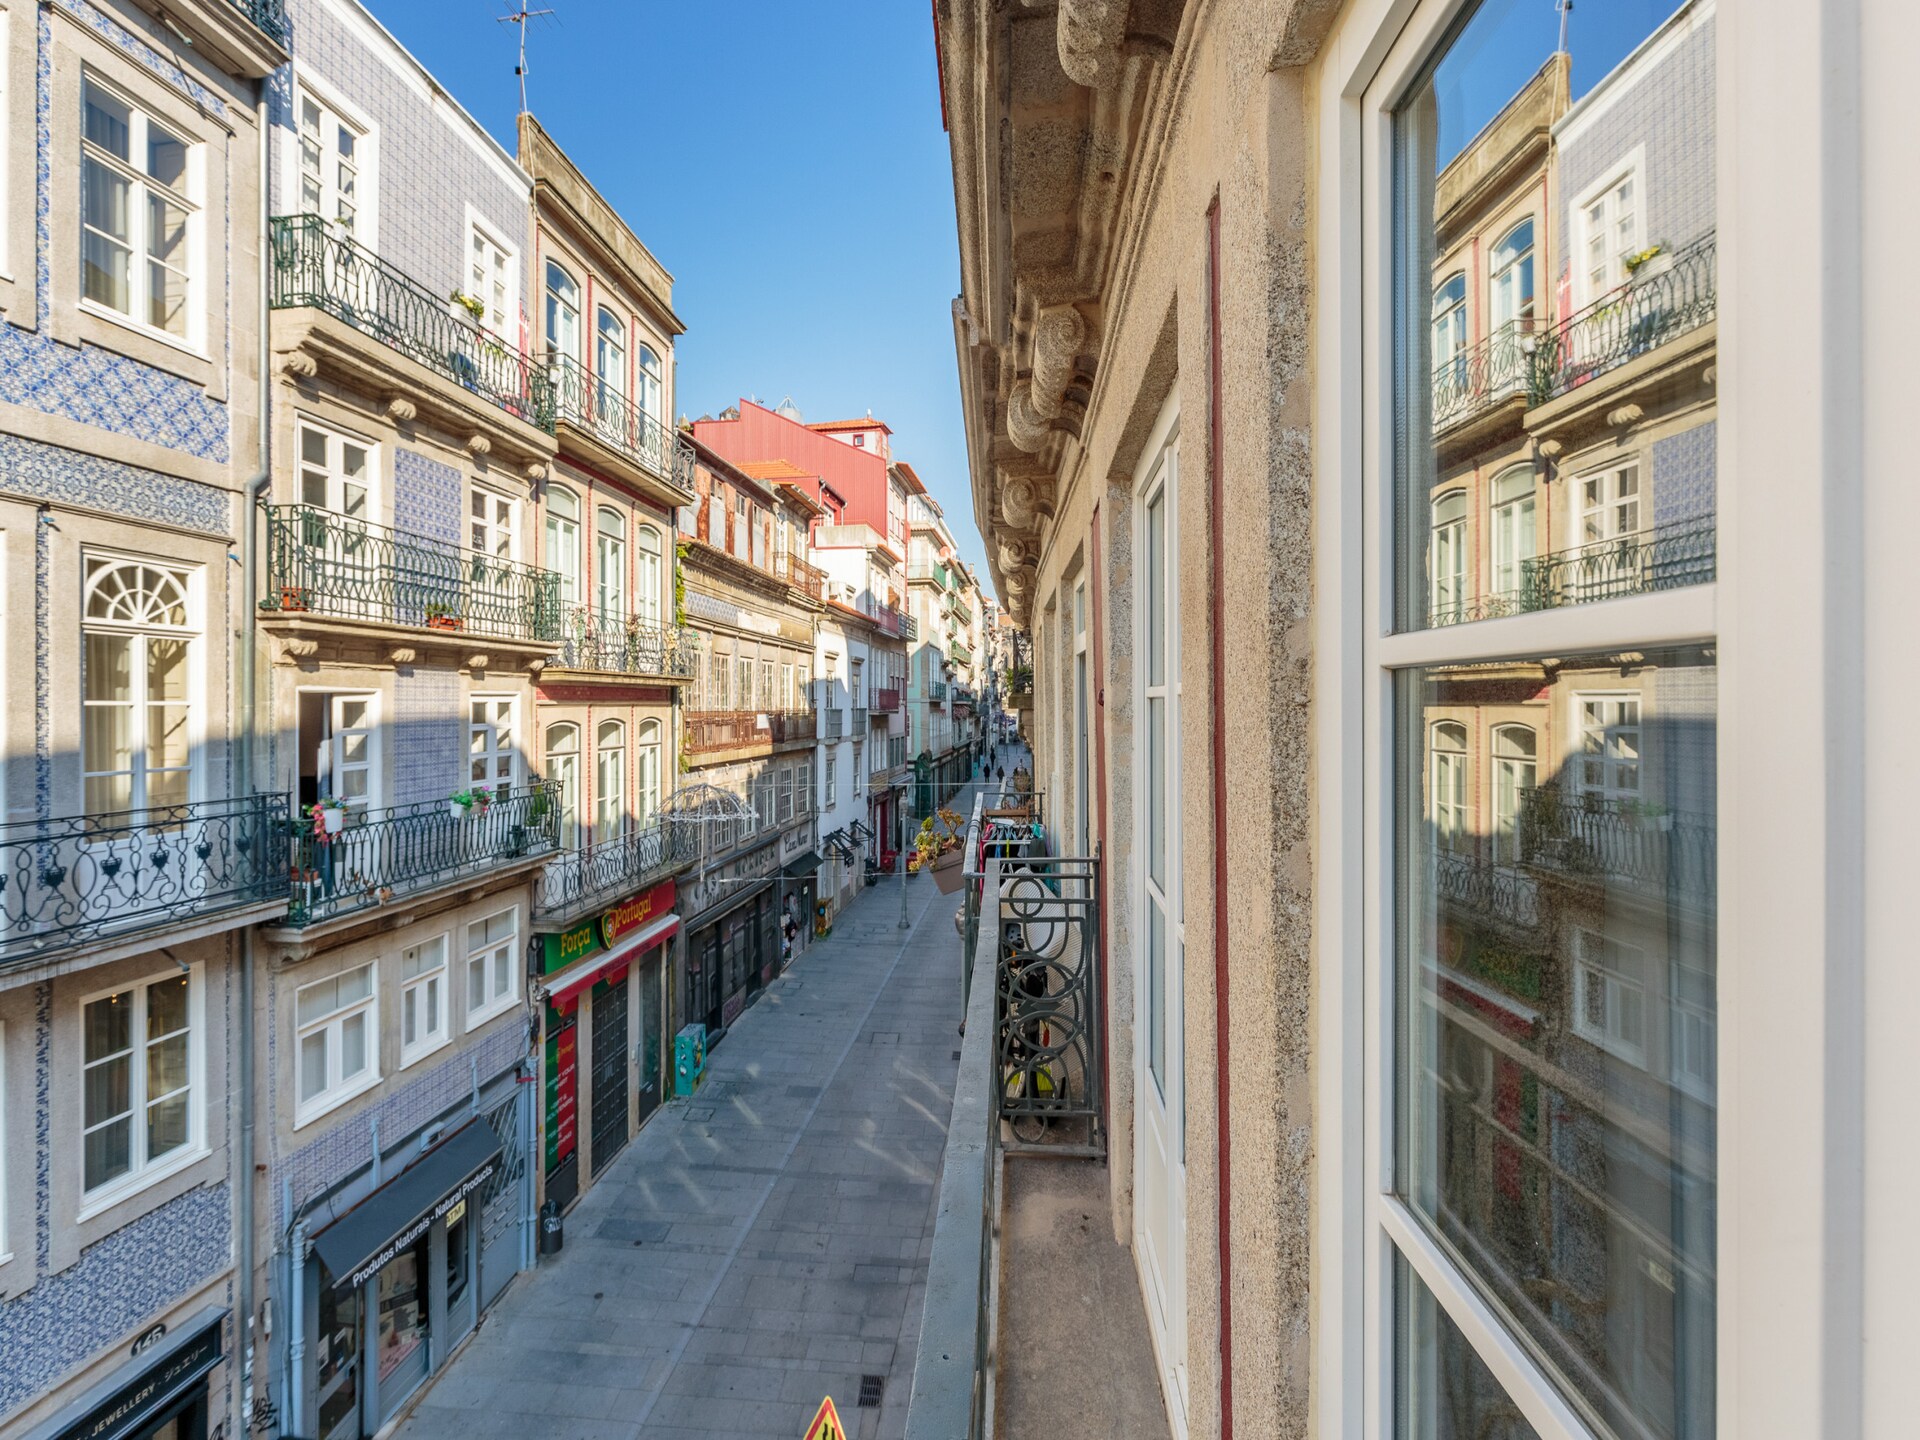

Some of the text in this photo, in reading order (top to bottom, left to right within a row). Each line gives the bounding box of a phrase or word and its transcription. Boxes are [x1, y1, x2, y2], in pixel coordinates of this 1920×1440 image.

[561, 893, 652, 957] Força Portugal
[352, 1246, 394, 1288] Produtos
[395, 1217, 430, 1252] Naturais
[435, 1188, 462, 1219] Natural
[462, 1165, 493, 1196] Products
[92, 1385, 155, 1437] JEWELLERY
